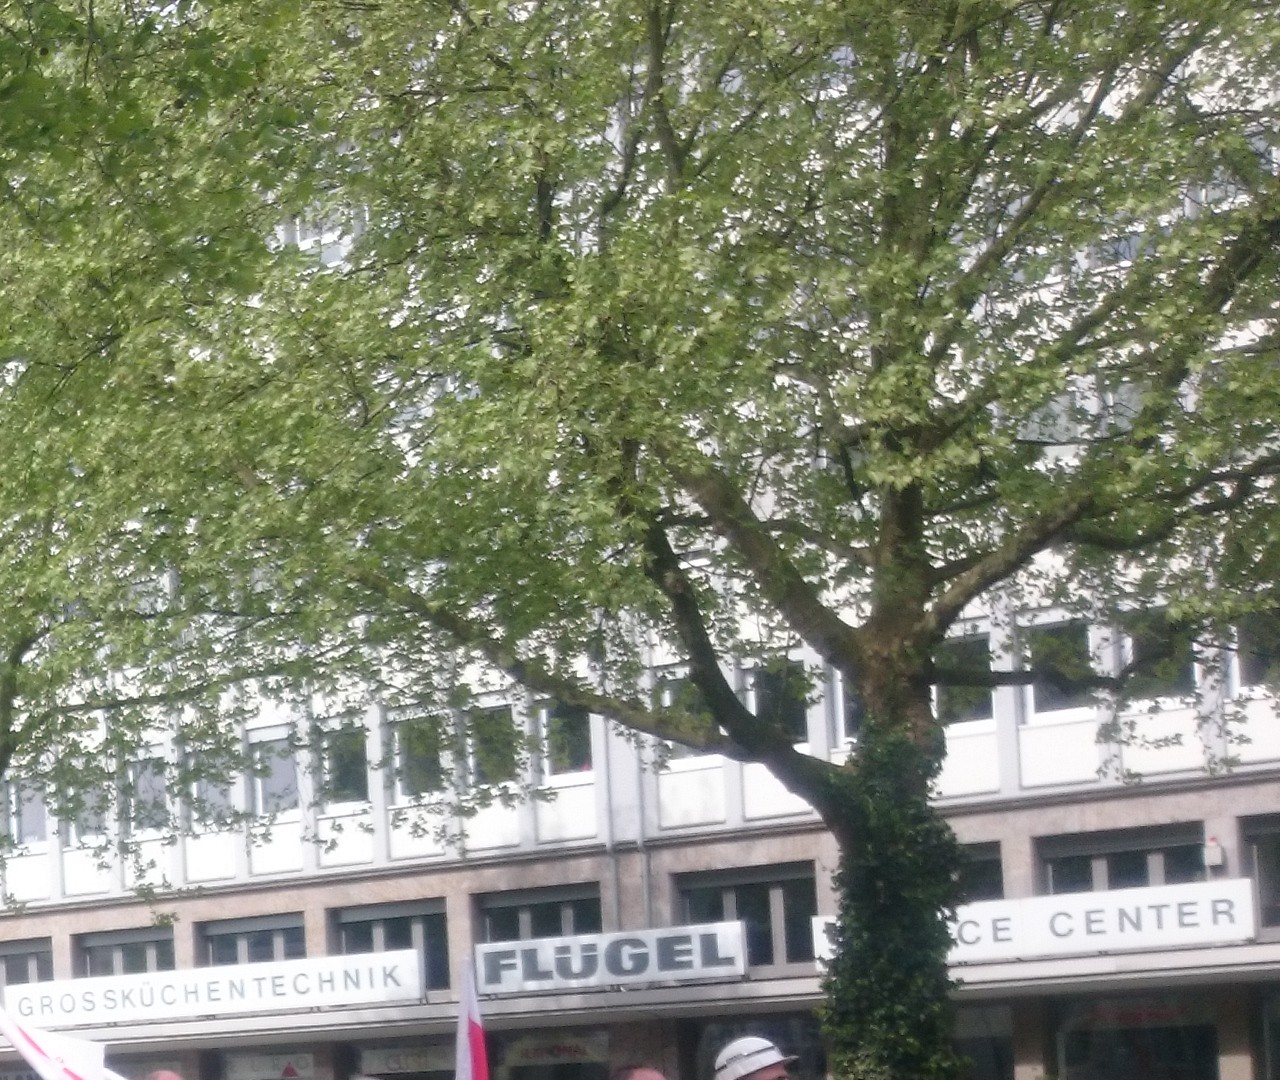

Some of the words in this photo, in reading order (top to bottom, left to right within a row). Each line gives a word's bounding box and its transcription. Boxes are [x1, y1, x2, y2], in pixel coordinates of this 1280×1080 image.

[1049, 898, 1236, 938] CENTER
[483, 932, 736, 985] FLÜGEL
[17, 964, 403, 1018] GROSSKÜCHENTECHNIK
